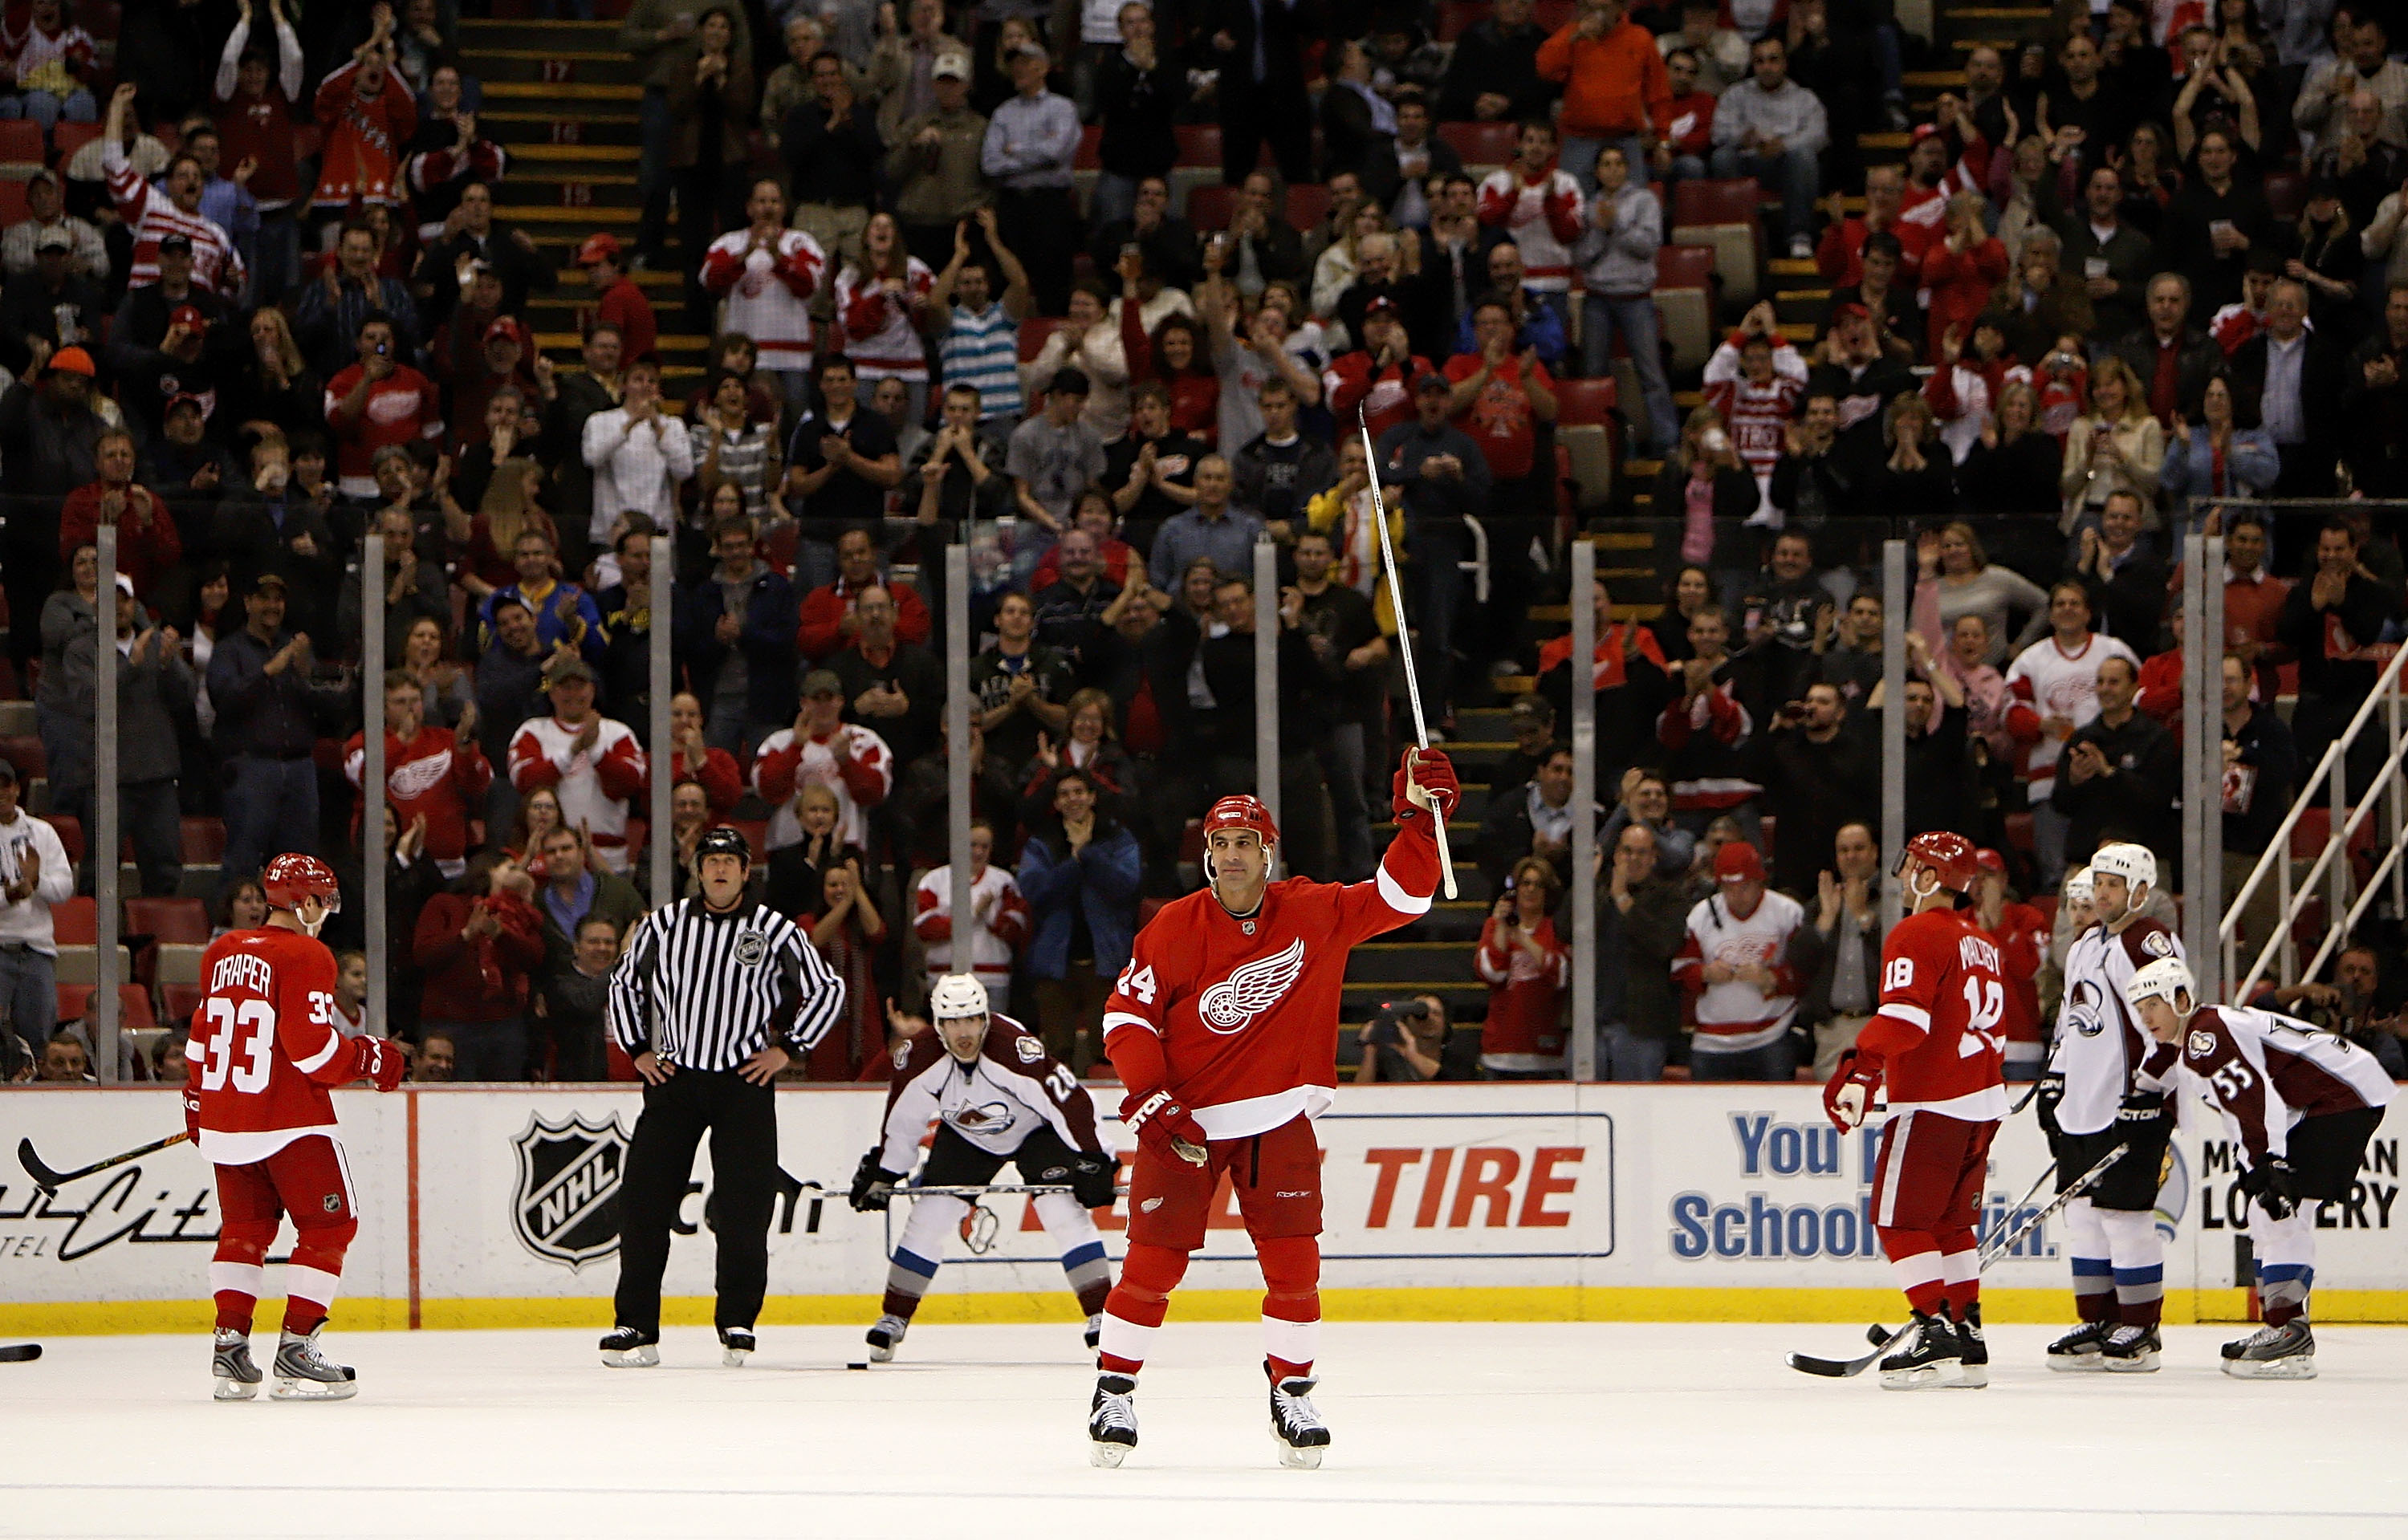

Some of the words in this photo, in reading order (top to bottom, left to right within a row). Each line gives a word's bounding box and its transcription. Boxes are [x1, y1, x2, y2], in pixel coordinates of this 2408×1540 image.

[210, 953, 272, 998] DRAPER
[1117, 957, 1157, 1005] 24
[1884, 957, 1914, 992] 18
[201, 997, 275, 1094] 33
[1045, 1063, 1077, 1103] 28
[2211, 1059, 2254, 1100] 55
[1731, 1115, 1840, 1175] You
[539, 1152, 616, 1237] NHL
[1365, 1147, 1586, 1229] TIRE
[2202, 1181, 2399, 1229] LOERY
[58, 1165, 222, 1262] Cit
